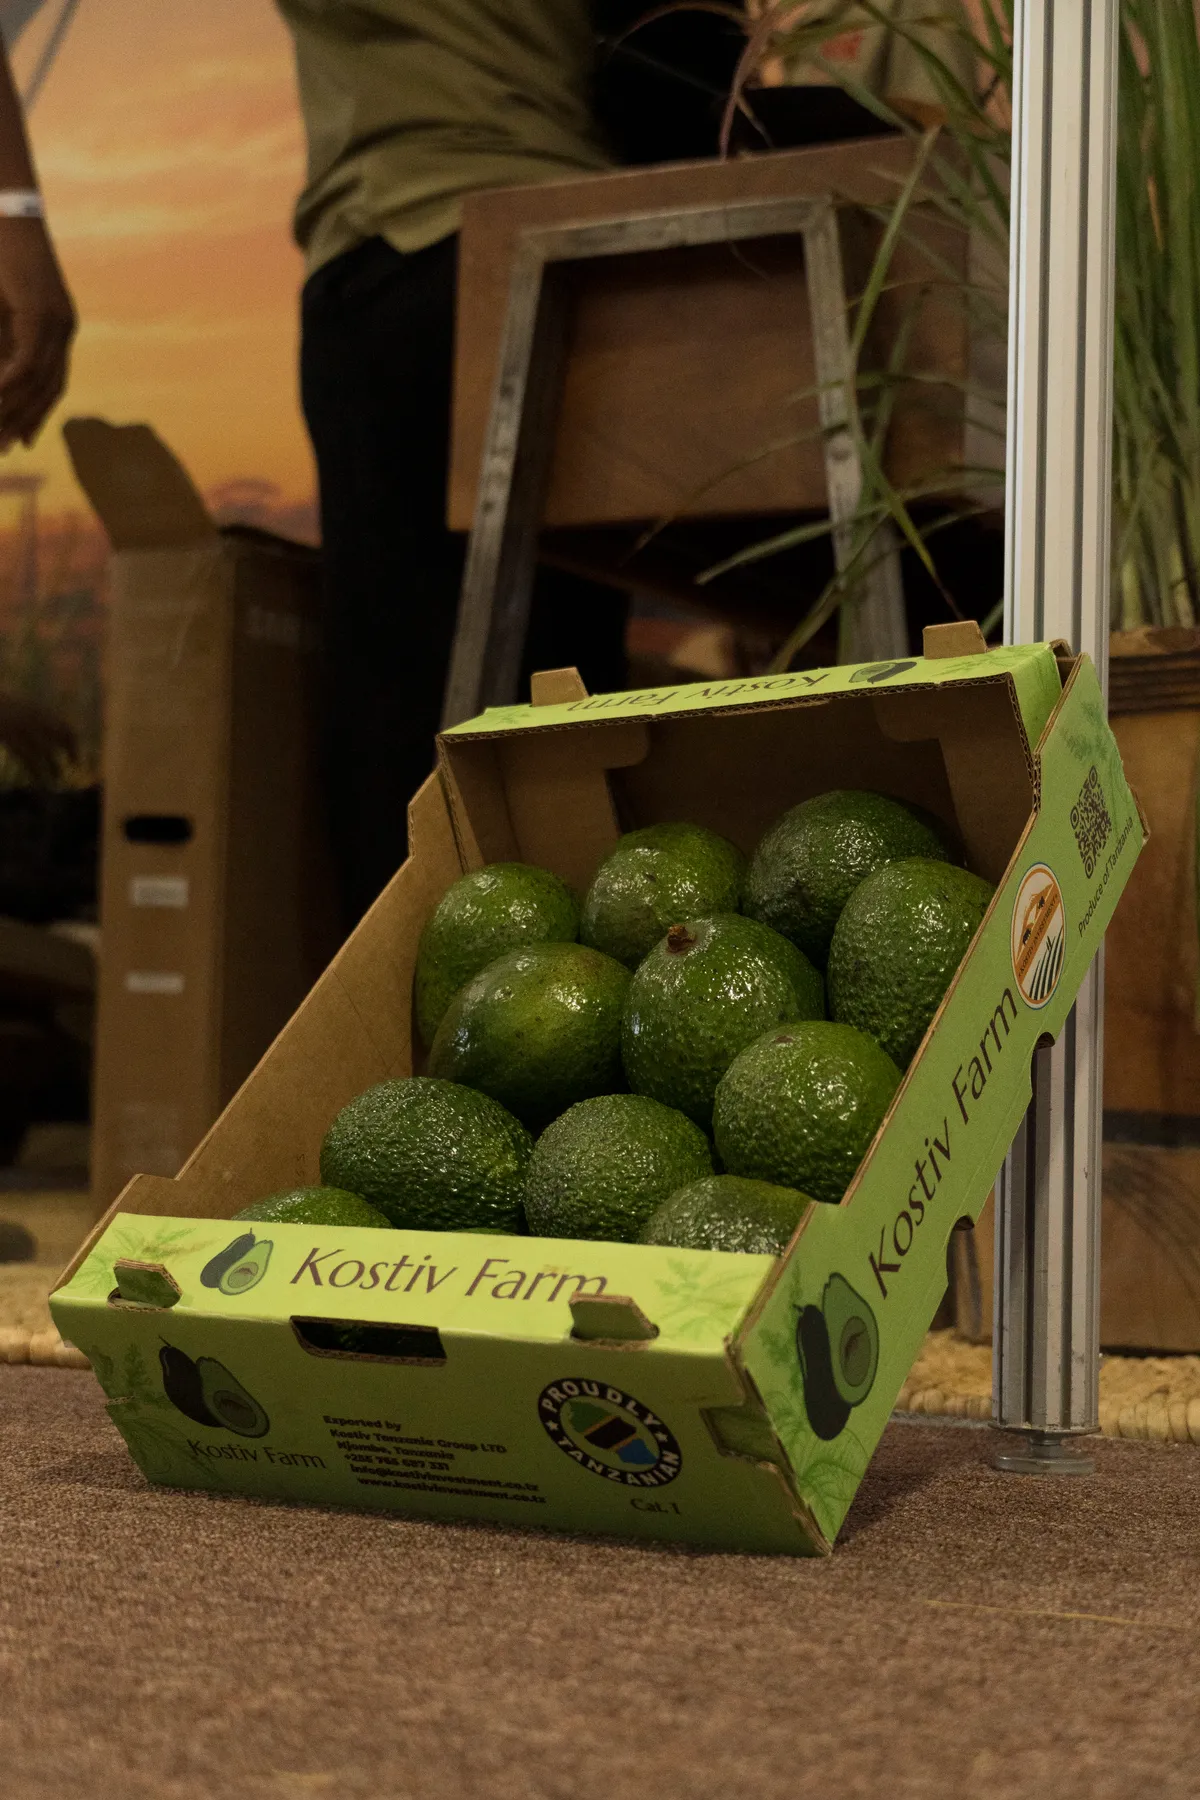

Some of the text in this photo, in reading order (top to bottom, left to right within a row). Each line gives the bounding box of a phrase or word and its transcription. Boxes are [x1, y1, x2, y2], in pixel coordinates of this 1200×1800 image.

[566, 673, 829, 712] Kostiv Farm
[1078, 816, 1134, 937] Produce of Tanzania
[868, 987, 1018, 1300] Kostiv Farm
[289, 1247, 608, 1302] Kostiv Farm
[323, 1415, 402, 1432] Exported by
[541, 1381, 662, 1426] PROUDLY
[187, 1439, 327, 1469] Kostiv Farm
[329, 1429, 507, 1454] Kostiv Tanzania Group LTD
[393, 1446, 455, 1461] Tanzania
[558, 1437, 680, 1486] TANZANIAN
